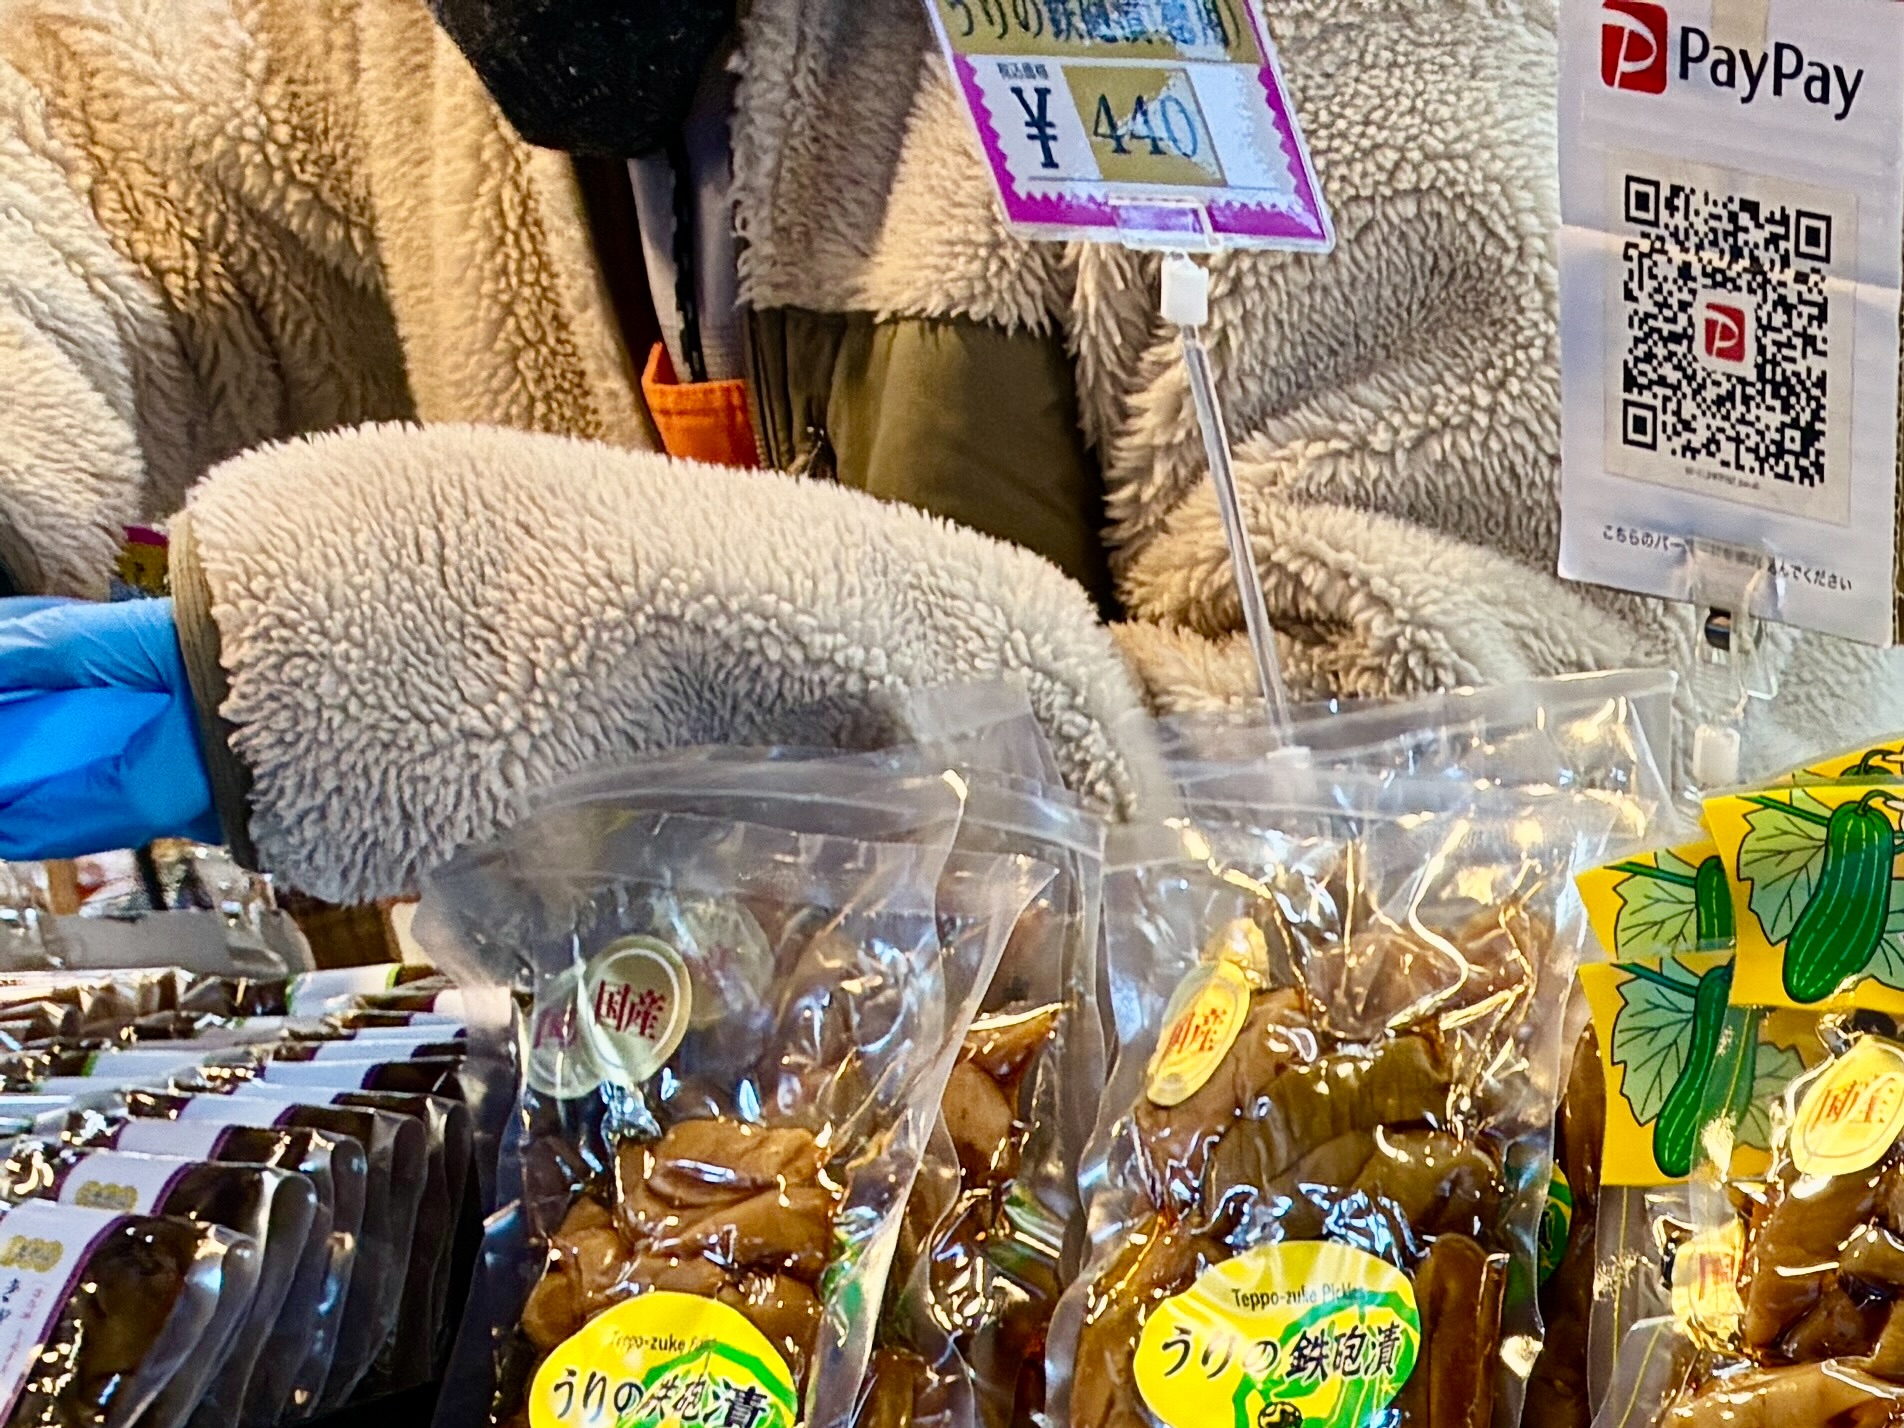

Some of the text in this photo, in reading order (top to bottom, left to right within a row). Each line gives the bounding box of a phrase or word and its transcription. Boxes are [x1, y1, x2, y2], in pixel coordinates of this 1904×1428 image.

[1679, 25, 1865, 121] PayPay
[1010, 87, 1199, 169] ¥ 440
[594, 979, 666, 1041] 国産
[1161, 1320, 1401, 1382] うりの鉄砲漬
